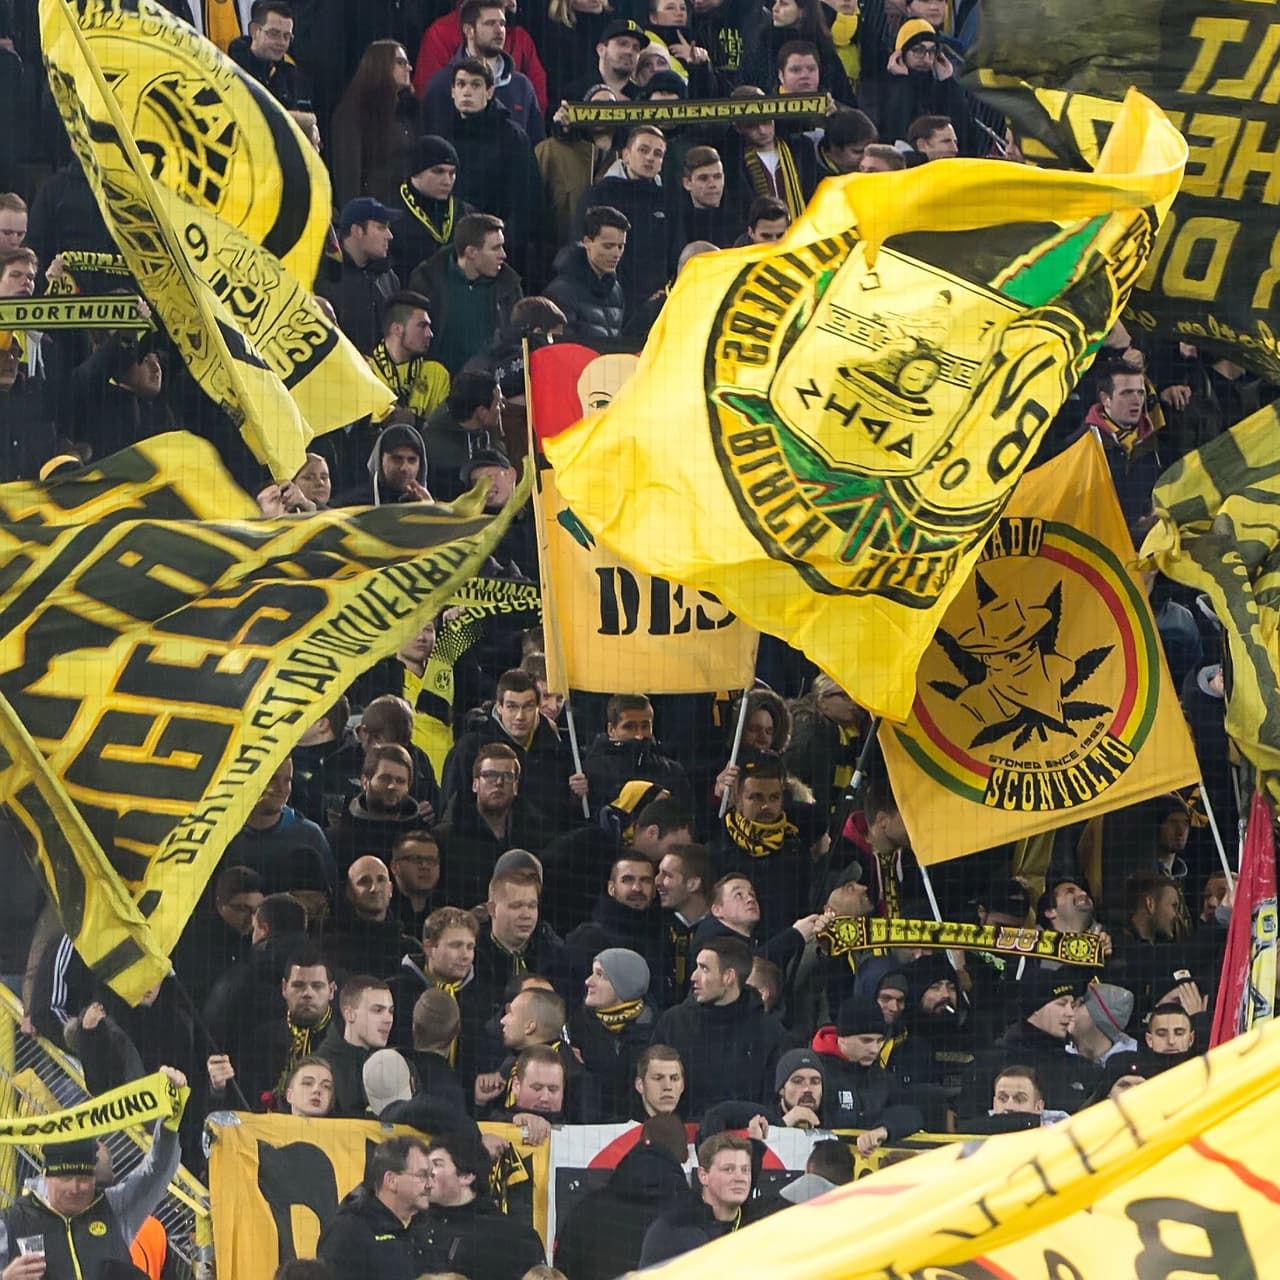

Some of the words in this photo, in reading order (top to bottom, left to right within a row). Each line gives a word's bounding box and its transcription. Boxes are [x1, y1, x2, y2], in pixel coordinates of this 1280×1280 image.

[576, 96, 817, 121] WESTFALENSTADION
[15, 304, 139, 321] DORTMUND
[26, 1090, 160, 1138] DORTMUND
